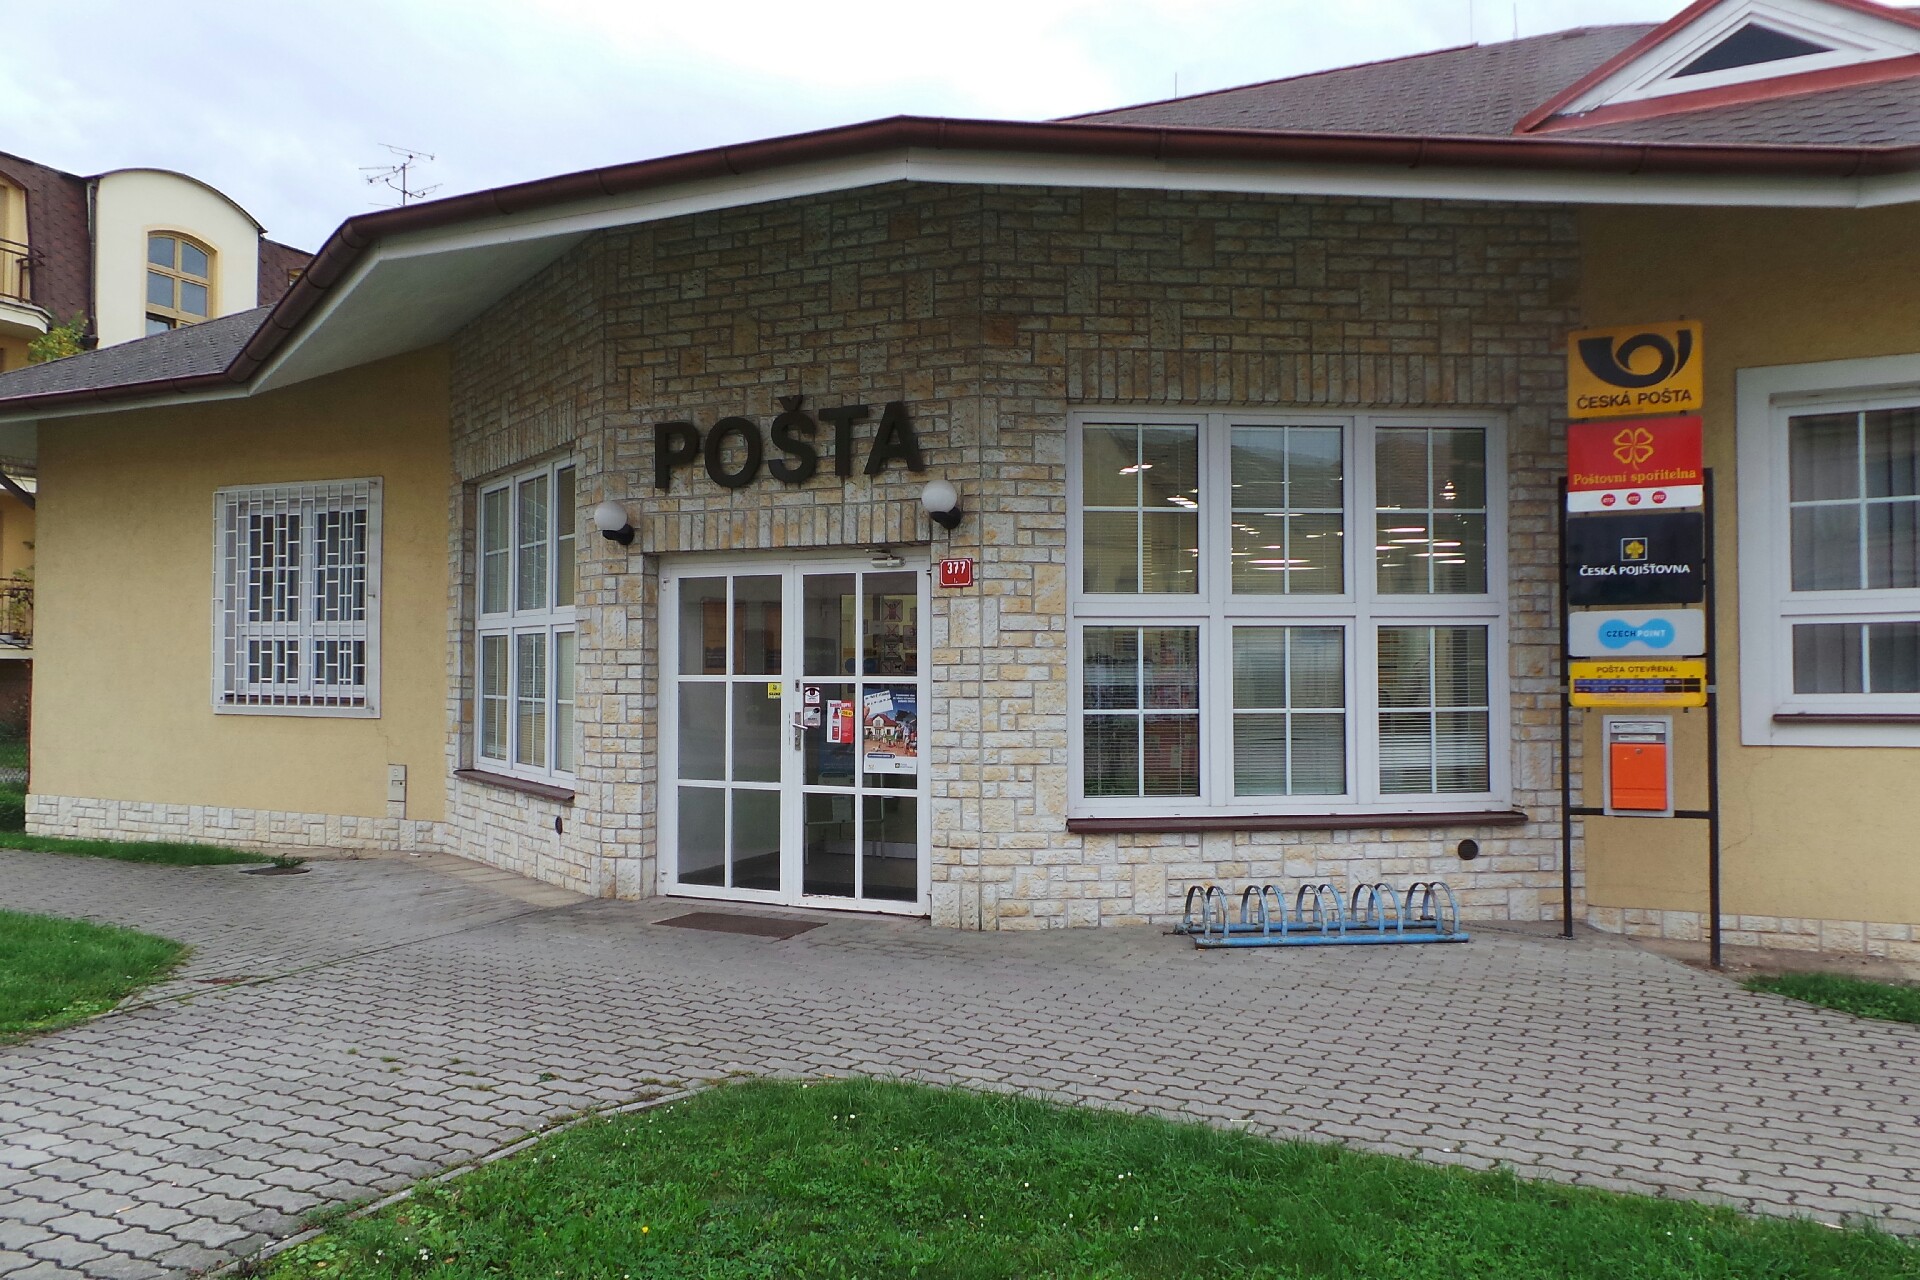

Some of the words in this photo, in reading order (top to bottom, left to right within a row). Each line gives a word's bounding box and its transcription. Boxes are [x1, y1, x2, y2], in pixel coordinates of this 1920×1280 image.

[1577, 391, 1631, 410] ČESKÁ
[1637, 388, 1693, 405] POŠTA
[654, 395, 925, 489] POŠTA
[1573, 471, 1627, 485] Poštovní
[1631, 468, 1696, 484] spořitelna
[947, 561, 966, 574] 377
[1579, 565, 1617, 576] ČESKÁ
[1619, 563, 1691, 576] POJIŠŤOVNA
[1637, 629, 1666, 637] POINT
[1596, 664, 1625, 673] POŠTA
